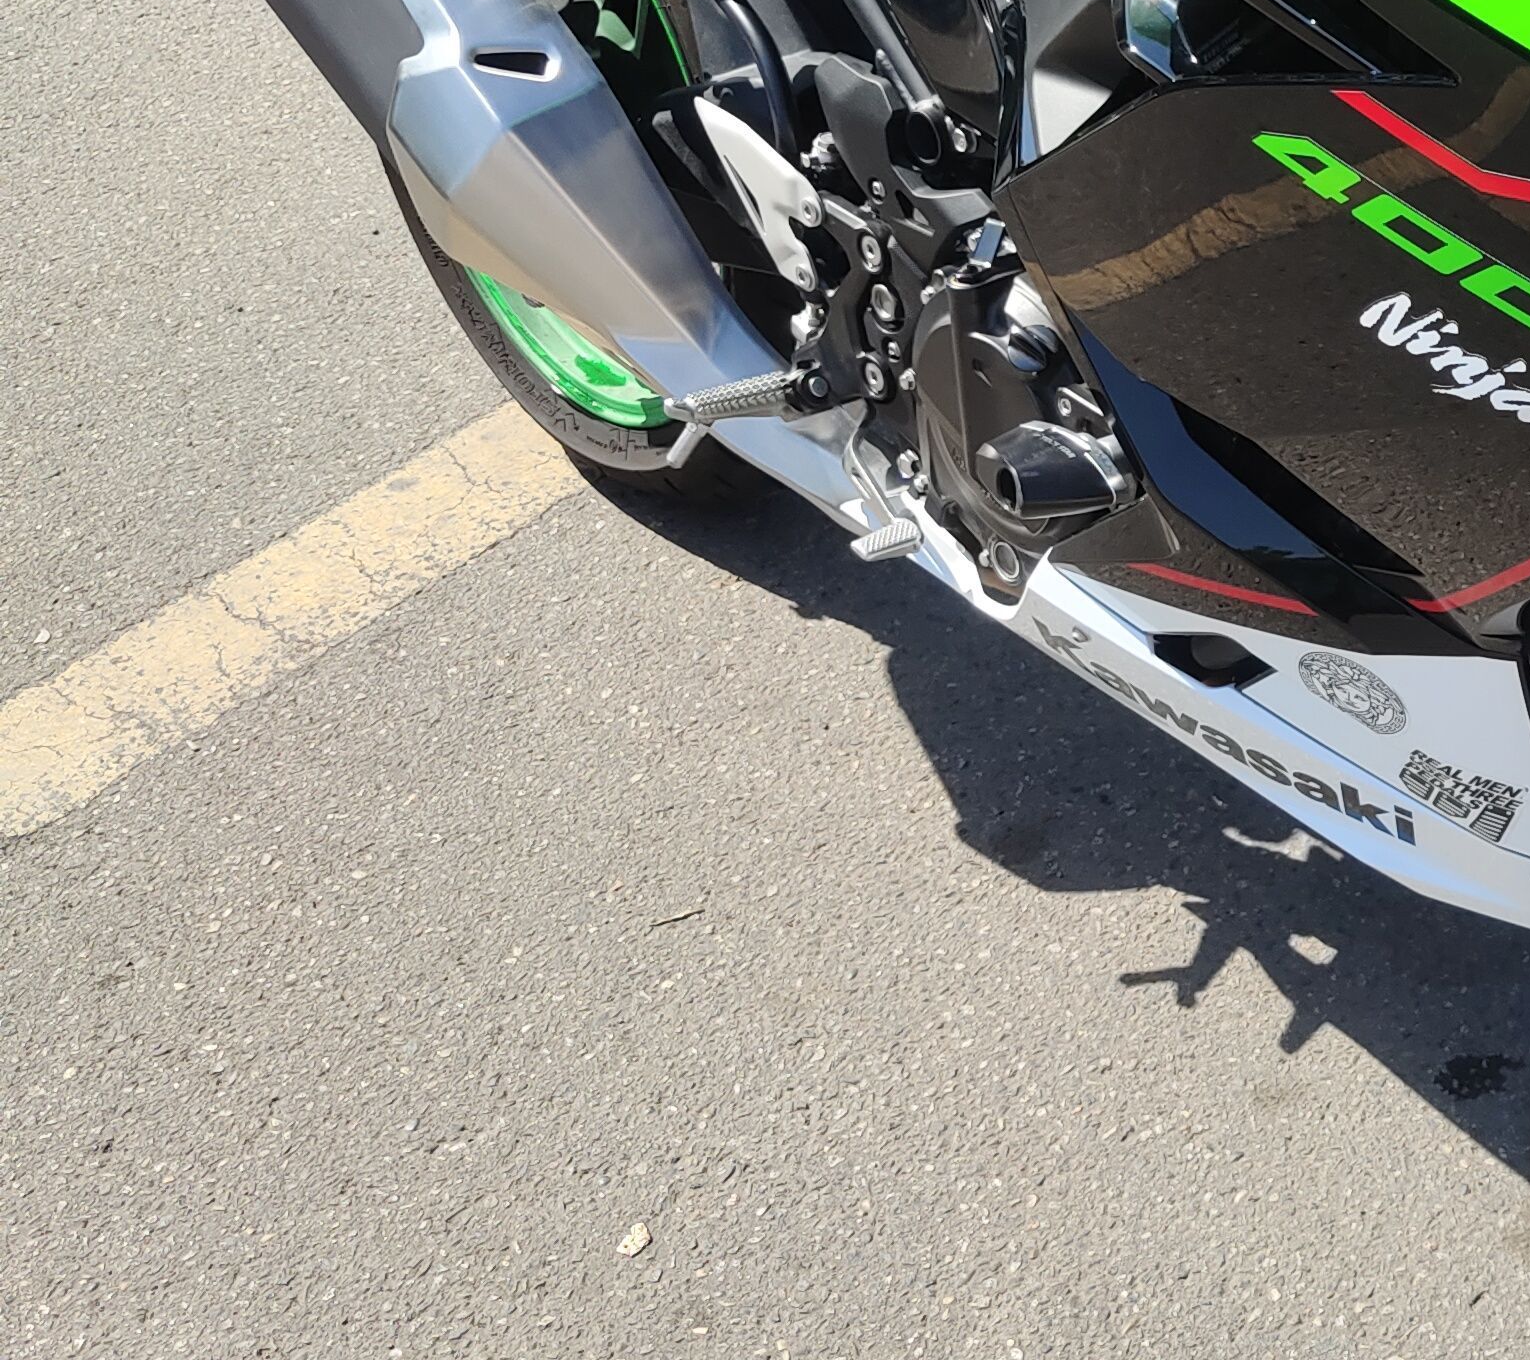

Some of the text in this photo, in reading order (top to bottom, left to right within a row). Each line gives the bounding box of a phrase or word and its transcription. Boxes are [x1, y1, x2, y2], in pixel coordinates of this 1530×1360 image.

[1033, 617, 1417, 847] Kawasaki
[1410, 749, 1522, 799] REAL MEN
[1452, 780, 1524, 812] THREE
